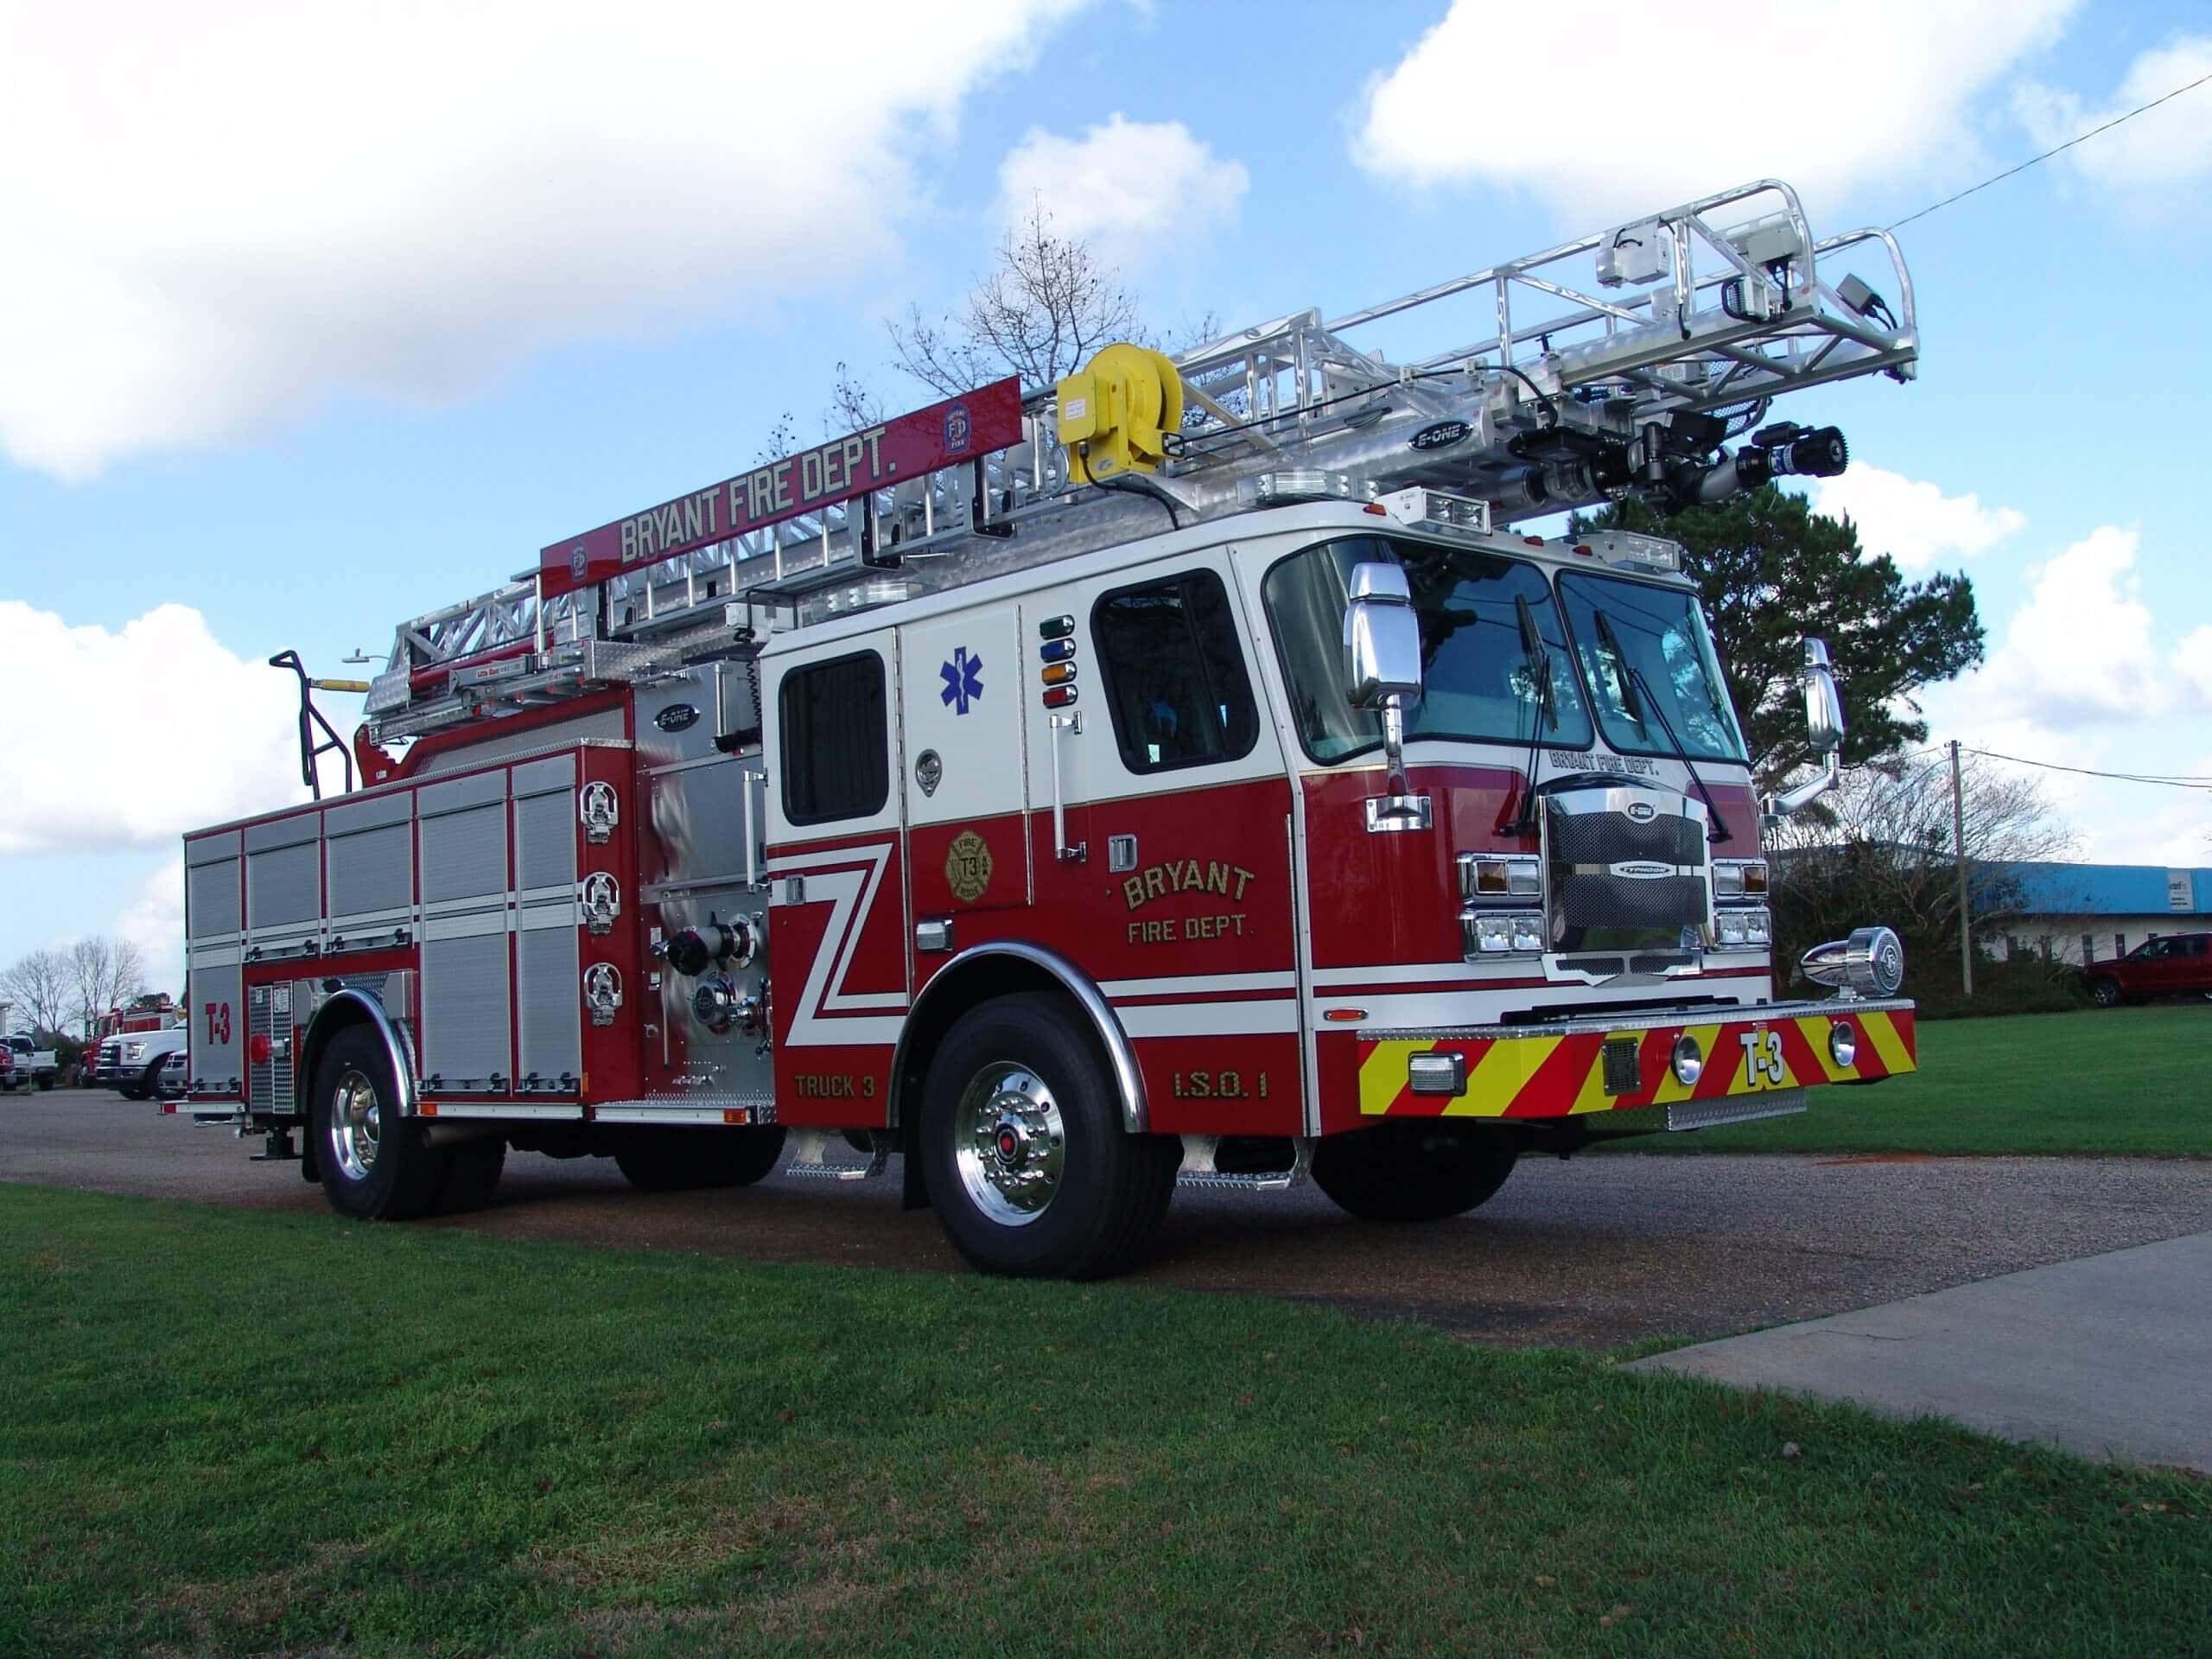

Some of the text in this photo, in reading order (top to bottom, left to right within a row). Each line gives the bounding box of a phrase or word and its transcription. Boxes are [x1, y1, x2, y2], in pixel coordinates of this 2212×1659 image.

[1417, 423, 1462, 448] E-ONE
[620, 426, 897, 563] BRYANT FIRE DEPT.
[659, 709, 690, 727] E-ONE
[1548, 749, 1660, 776] BRYANT FIRE DEPT.
[958, 836, 978, 849] FIRE
[960, 856, 977, 877] T3
[1122, 858, 1255, 912] BRYANT
[1127, 912, 1255, 944] FIRE DEPT.
[204, 1001, 232, 1046] T-3
[1738, 1030, 1785, 1088] T-3
[793, 1074, 876, 1098] TRUCK 3
[1173, 1071, 1249, 1098] I.S.O.
